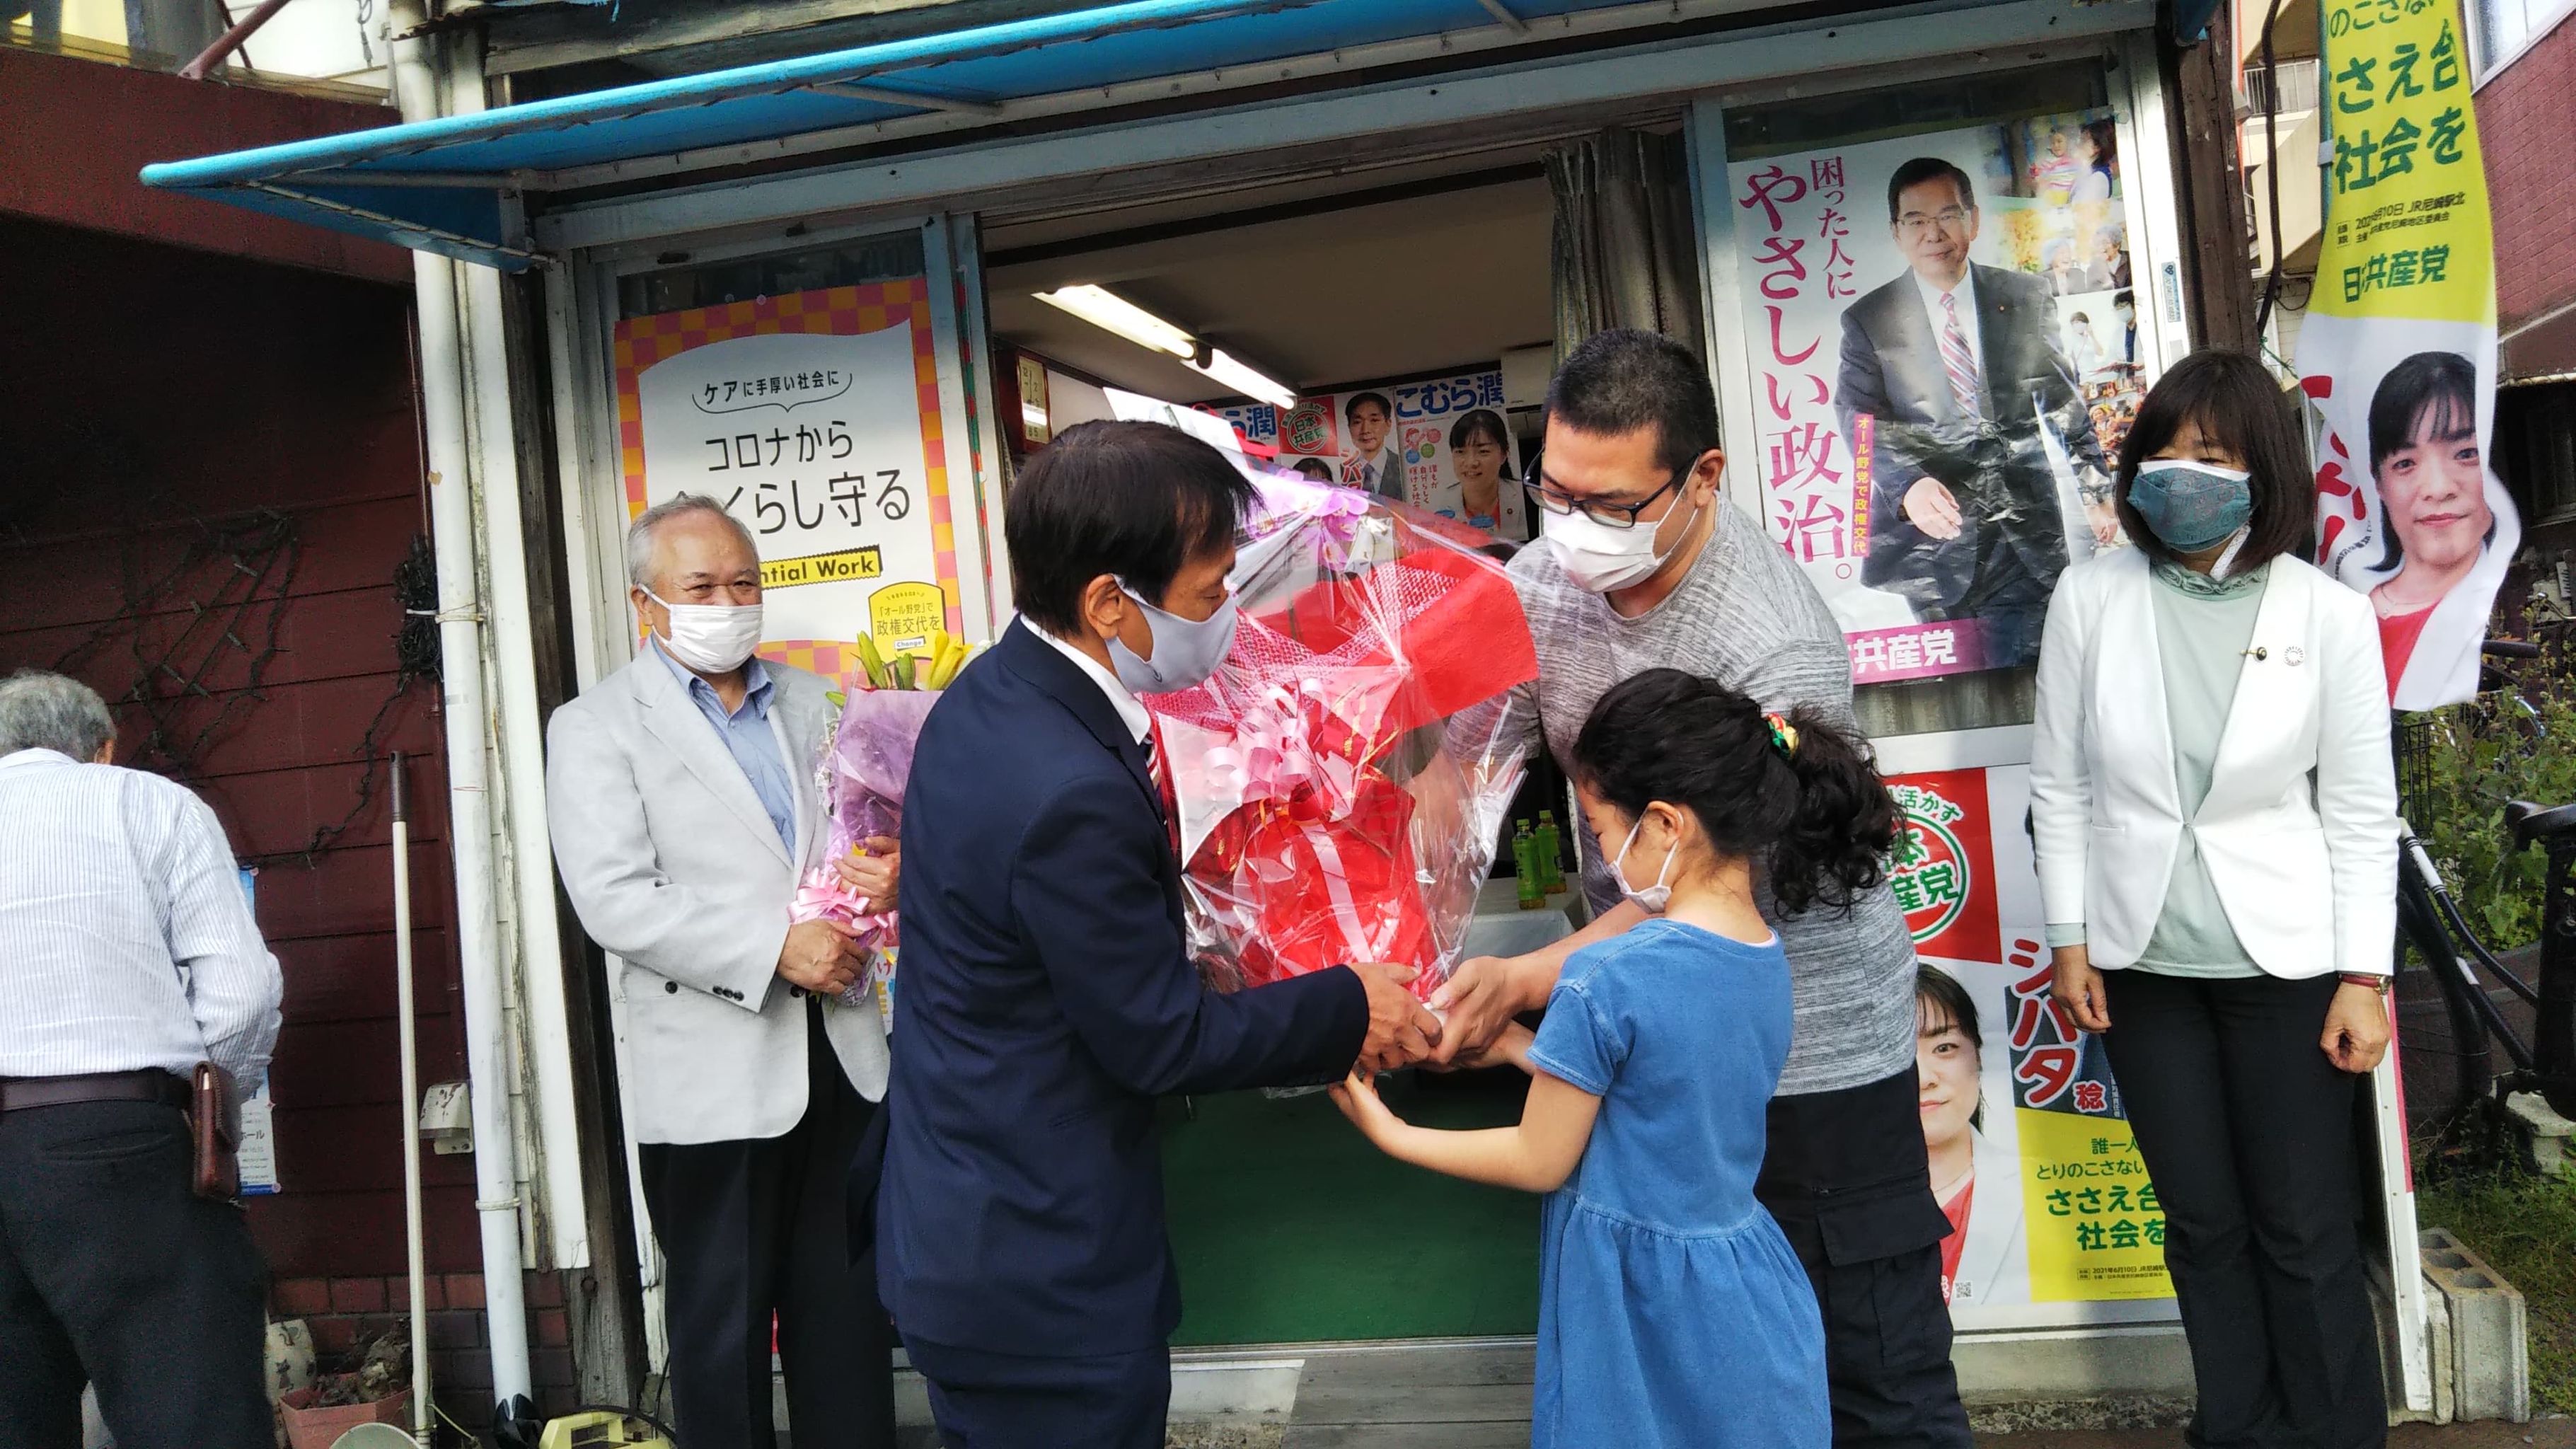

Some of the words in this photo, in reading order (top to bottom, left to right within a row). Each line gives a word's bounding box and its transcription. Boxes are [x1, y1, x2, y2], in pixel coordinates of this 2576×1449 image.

[2335, 107, 2465, 194] 社会を
[1810, 155, 1856, 300] 困った人に
[2343, 243, 2450, 303] 日共産党
[703, 369, 839, 405] ケアに手厚い社会に
[1396, 371, 1505, 417] こむら潤
[1738, 163, 1852, 580] やさしい政治。
[705, 420, 853, 471] コロナから
[1295, 415, 1317, 432] 日本
[1853, 417, 1870, 554] オール野党で政権交代
[816, 555, 874, 578] Work
[876, 614, 940, 636] 政権交代を
[1847, 628, 1958, 674] 共産党
[2091, 1136, 2140, 1155] 誰一人
[2037, 1160, 2143, 1180] とりのこさない
[2076, 1218, 2165, 1252] 社会を
